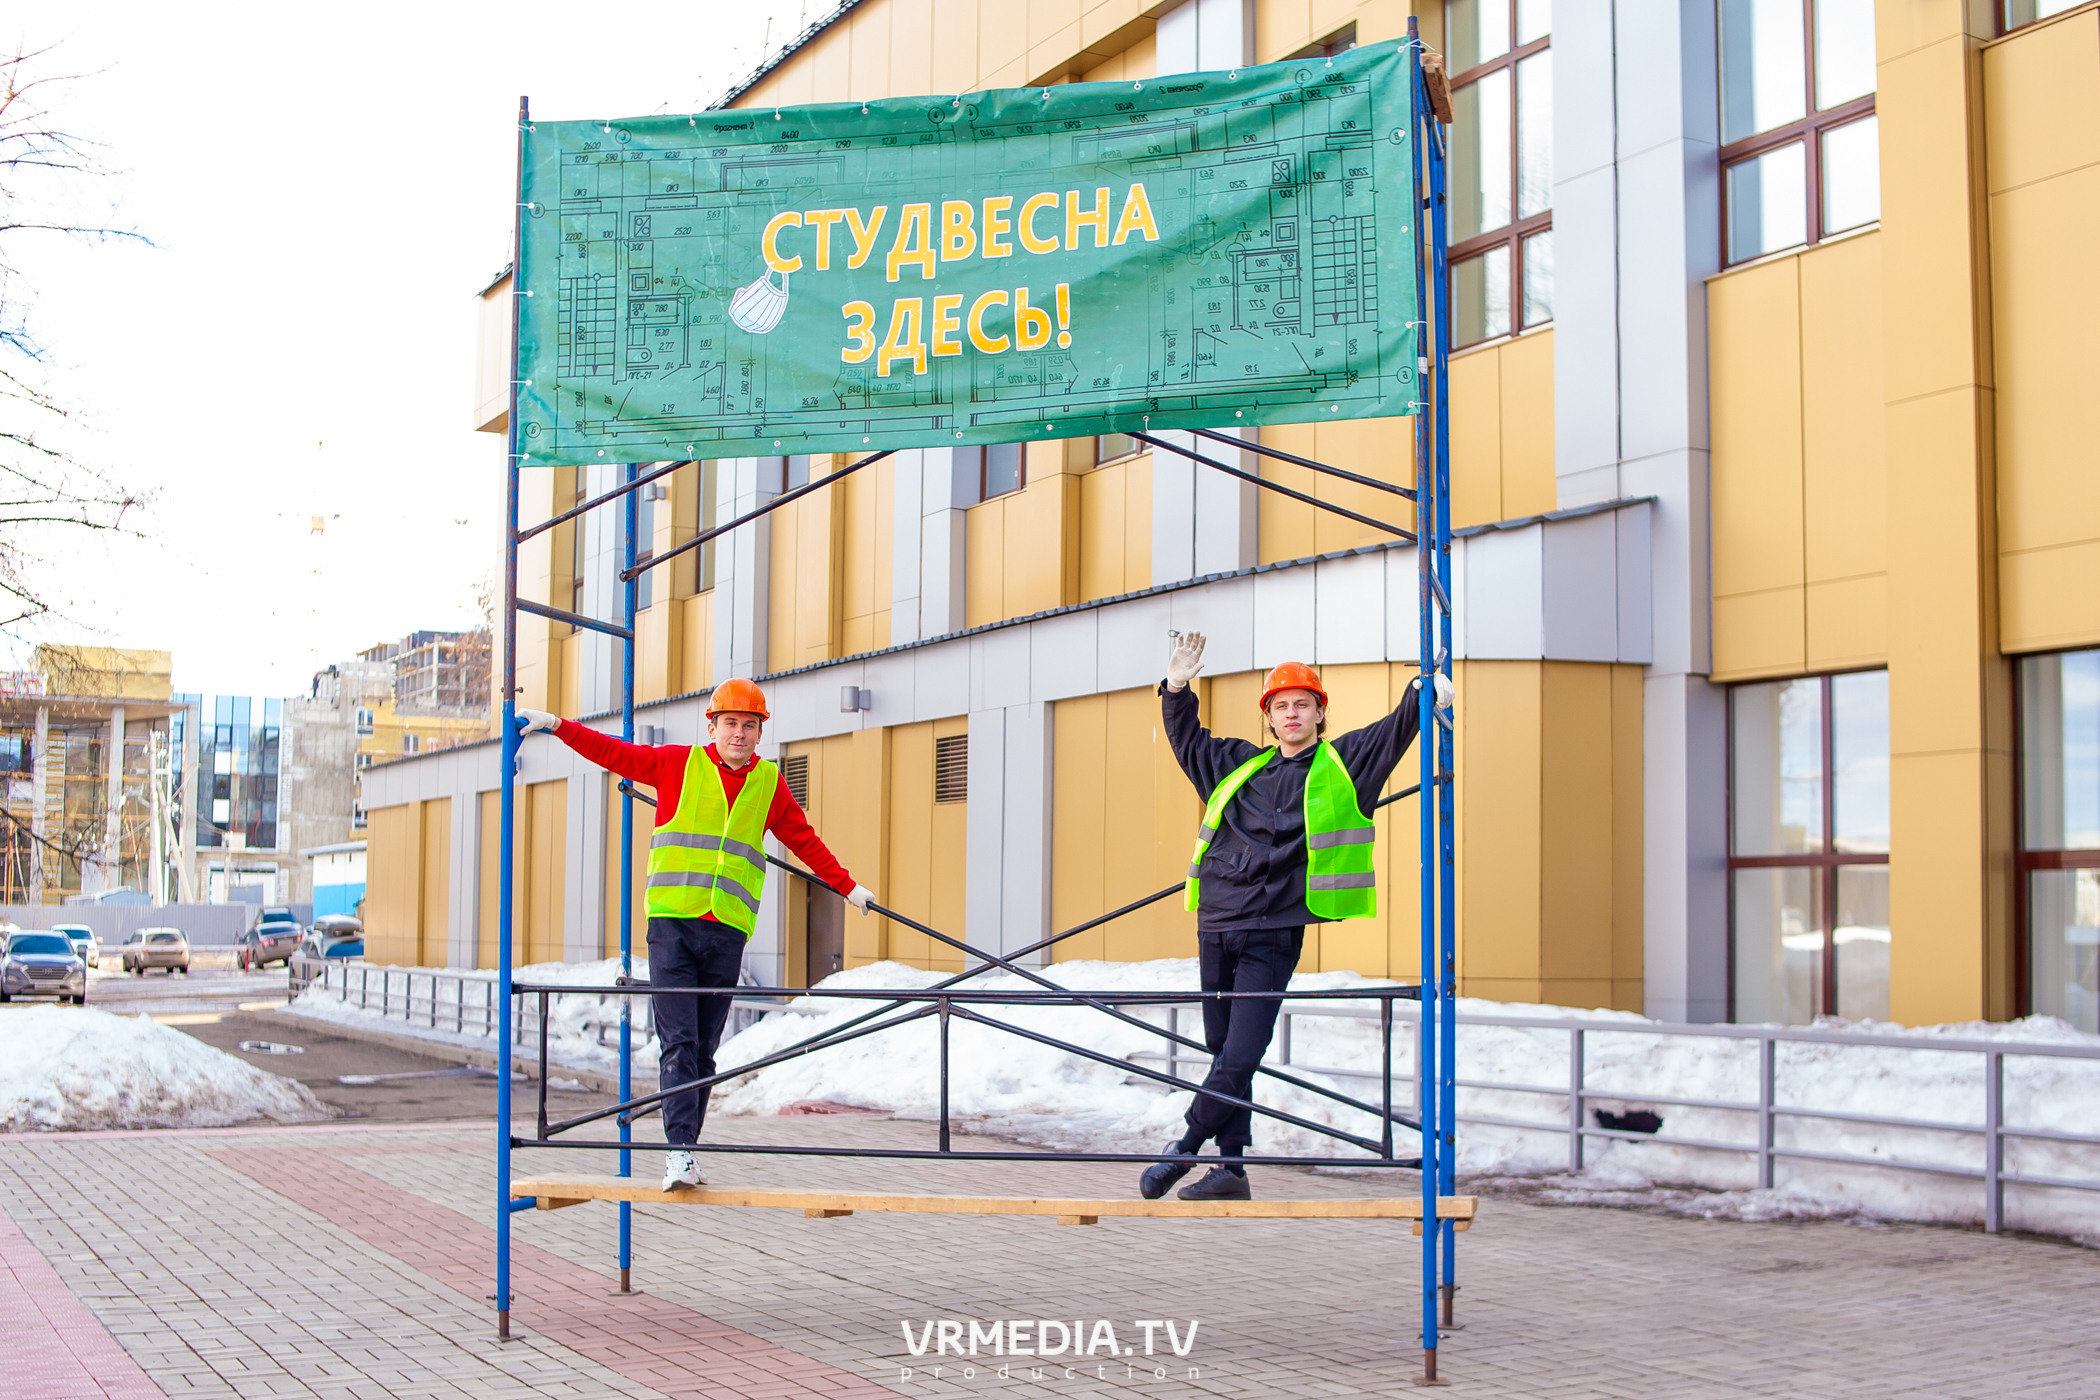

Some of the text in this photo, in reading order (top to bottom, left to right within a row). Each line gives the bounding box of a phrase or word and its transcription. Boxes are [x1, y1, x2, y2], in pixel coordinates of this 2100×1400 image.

[781, 130, 799, 139] 8400
[920, 134, 933, 143] 640
[835, 140, 851, 148] 1290
[882, 137, 897, 145] 1230
[583, 142, 601, 150] 2600
[770, 144, 788, 153] 2020
[630, 151, 643, 159] 700
[664, 151, 681, 159] 1230
[712, 148, 727, 157] 1290
[574, 155, 588, 163] 1210
[605, 153, 618, 161] 590
[602, 230, 614, 238] 100
[674, 227, 692, 235] 2520
[761, 183, 1161, 283] СТУДВЕСНА
[565, 232, 582, 241] 2200
[630, 243, 644, 251] 300
[655, 304, 668, 313] 780
[709, 315, 722, 323] 990
[654, 329, 670, 337] 1530
[840, 282, 1073, 377] ЗДЕСЬ!
[706, 385, 720, 394] 460
[848, 385, 861, 393] 640
[872, 384, 882, 392] 40
[886, 383, 901, 391] 1170
